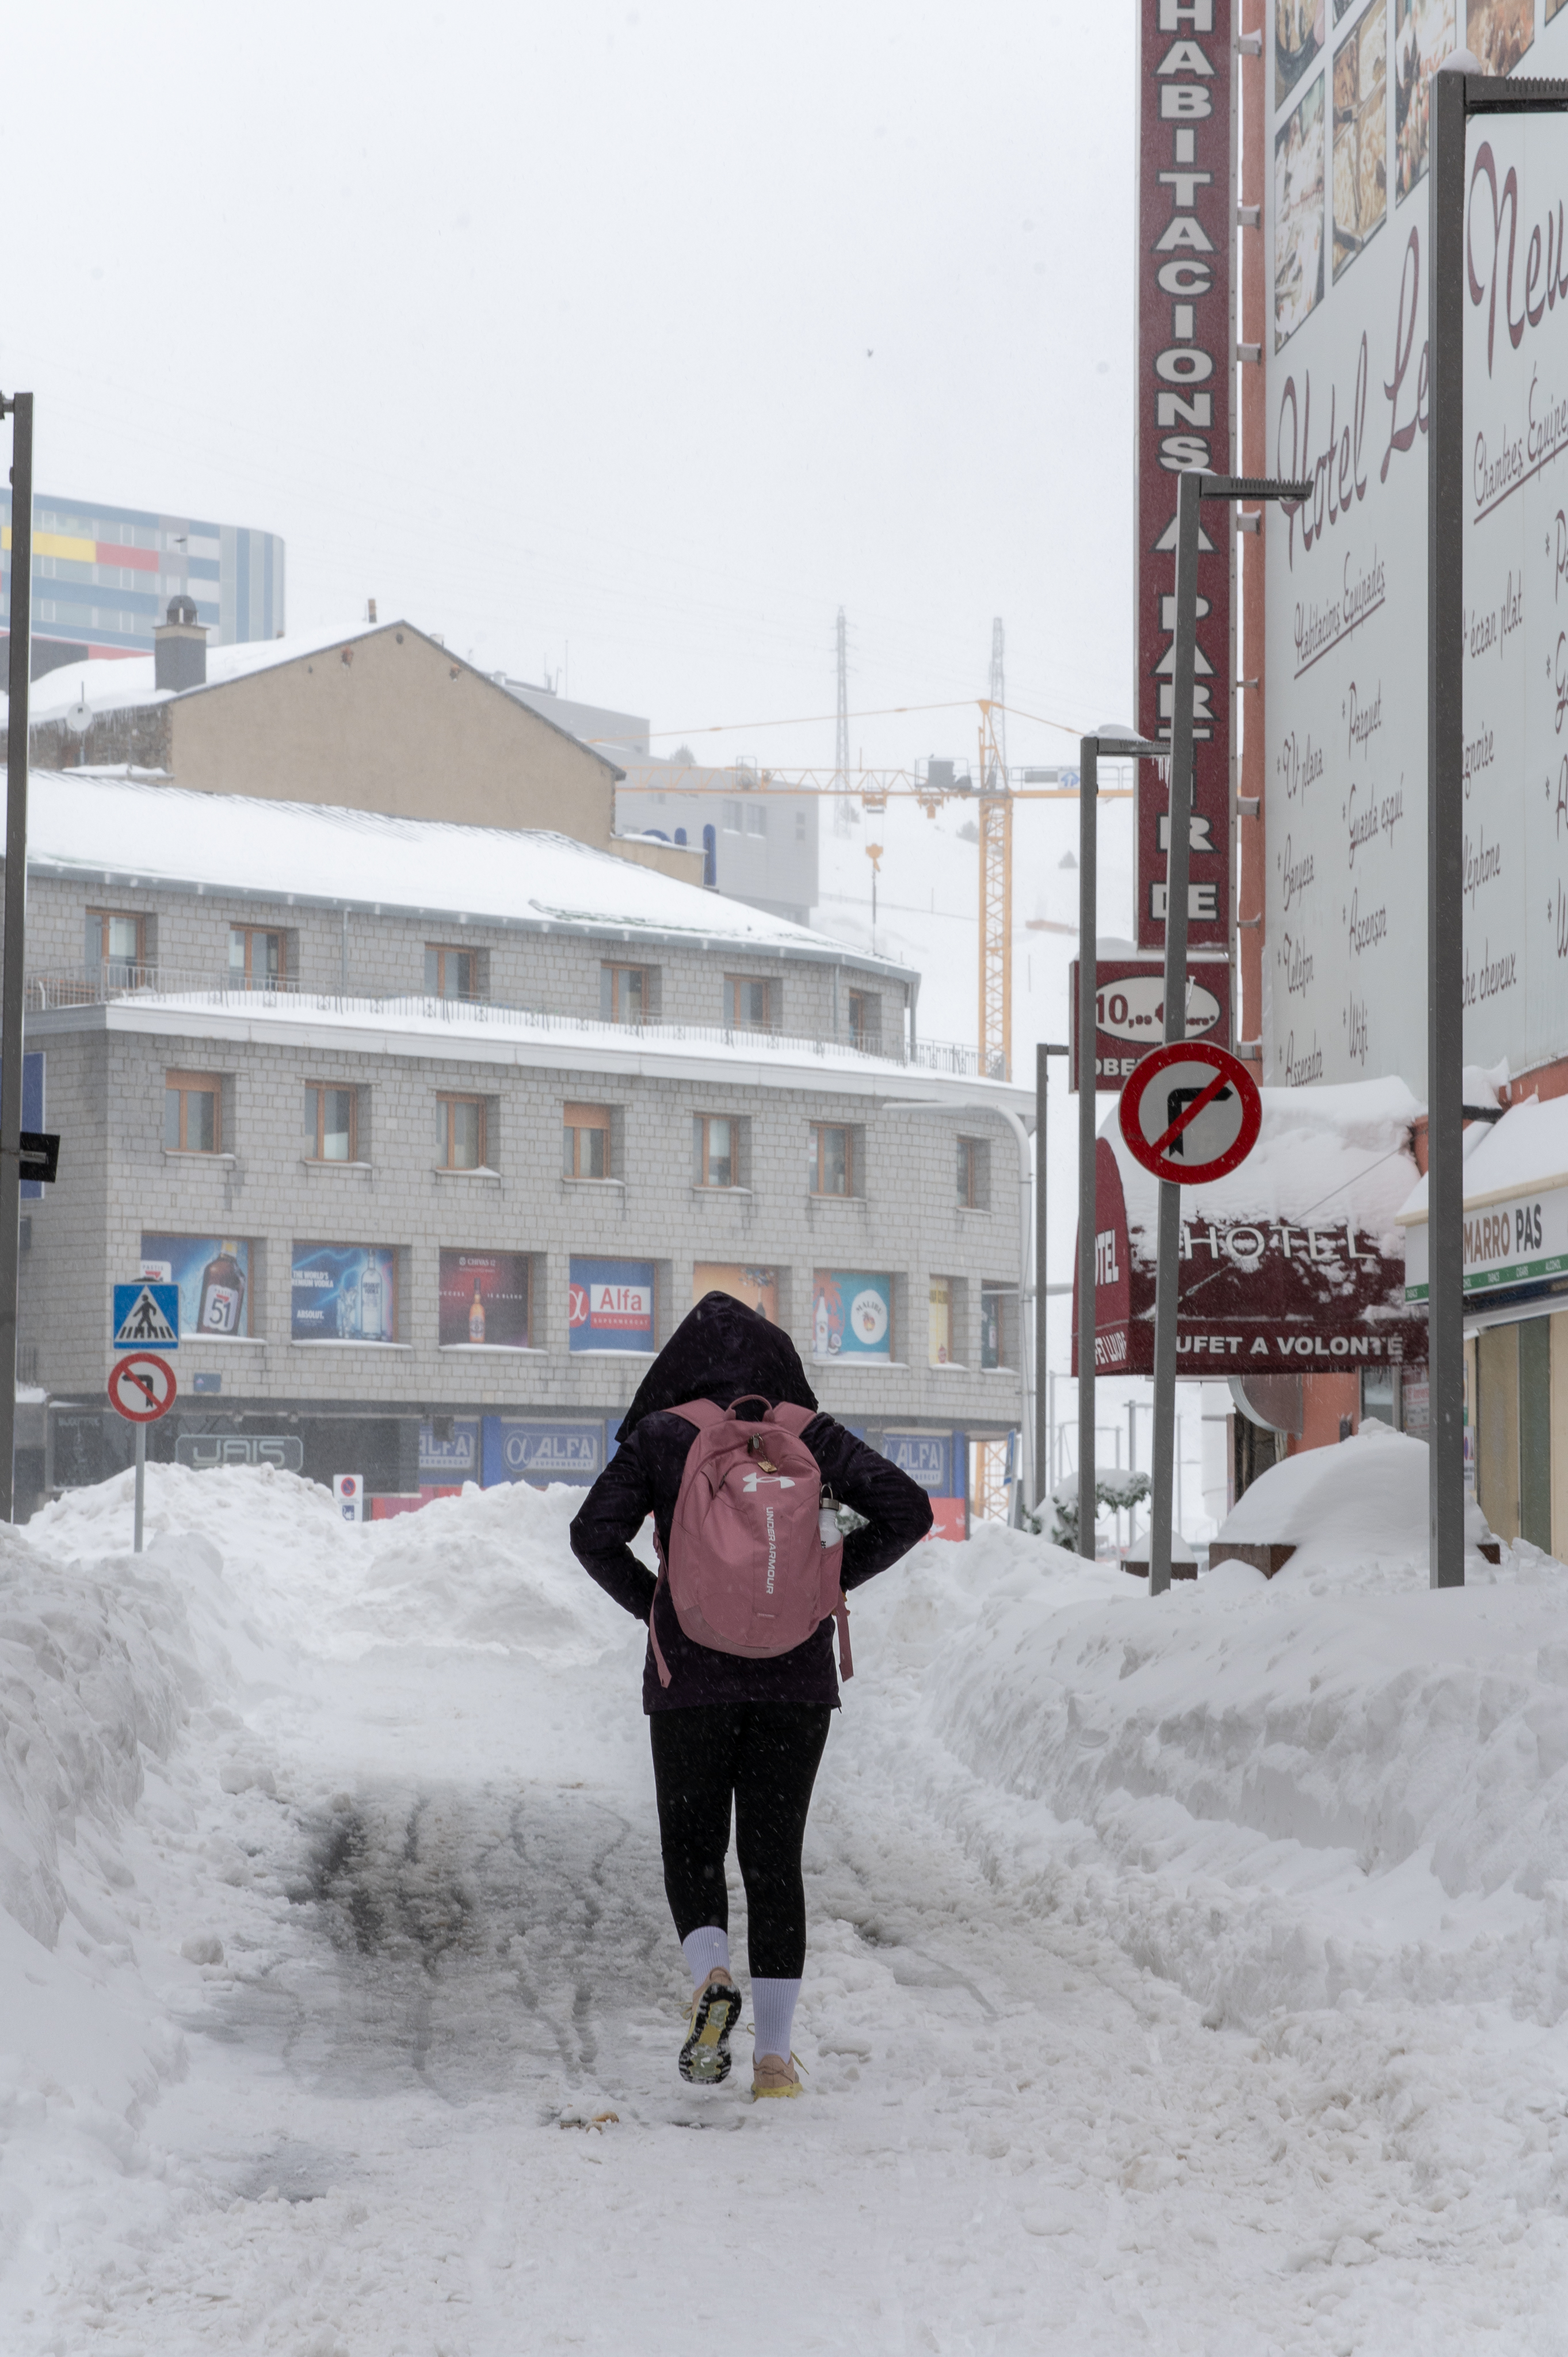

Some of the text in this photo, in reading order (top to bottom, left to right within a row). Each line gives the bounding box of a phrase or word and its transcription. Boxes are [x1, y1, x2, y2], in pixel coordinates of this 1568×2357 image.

[1153, 0, 1216, 472] HABITACIONS
[1277, 329, 1367, 573] Hotel
[1474, 423, 1524, 507] Chambres
[1295, 597, 1340, 666] Habitacions
[1343, 542, 1386, 642] Equipades
[1500, 569, 1523, 661] plat
[1153, 594, 1217, 853] PARTR
[1348, 678, 1382, 761] Parquet
[1301, 733, 1323, 808] plana
[1462, 720, 1494, 800] gnoire
[1349, 783, 1378, 870] Guarda
[1283, 833, 1314, 912] Banyera
[1462, 823, 1501, 911] léphone
[1349, 886, 1387, 960] Ascensor
[1283, 932, 1314, 998] Telèfon
[1479, 936, 1517, 1001] cheveux
[1285, 1029, 1323, 1087] Assecador
[1349, 990, 1369, 1067] Wifi
[467, 1257, 489, 1266] CHIVAS
[1095, 1228, 1119, 1287] TEL
[1184, 1225, 1377, 1260] HOTEL
[1516, 1203, 1542, 1253] PAS
[209, 1297, 231, 1328] 51
[600, 1287, 642, 1311] Alfa
[1177, 1336, 1243, 1354] UFET
[1250, 1336, 1269, 1354] A
[535, 1437, 592, 1458] ALFA
[895, 1443, 939, 1469] ALFA
[766, 1507, 776, 1595] UNDER ARMOUR
